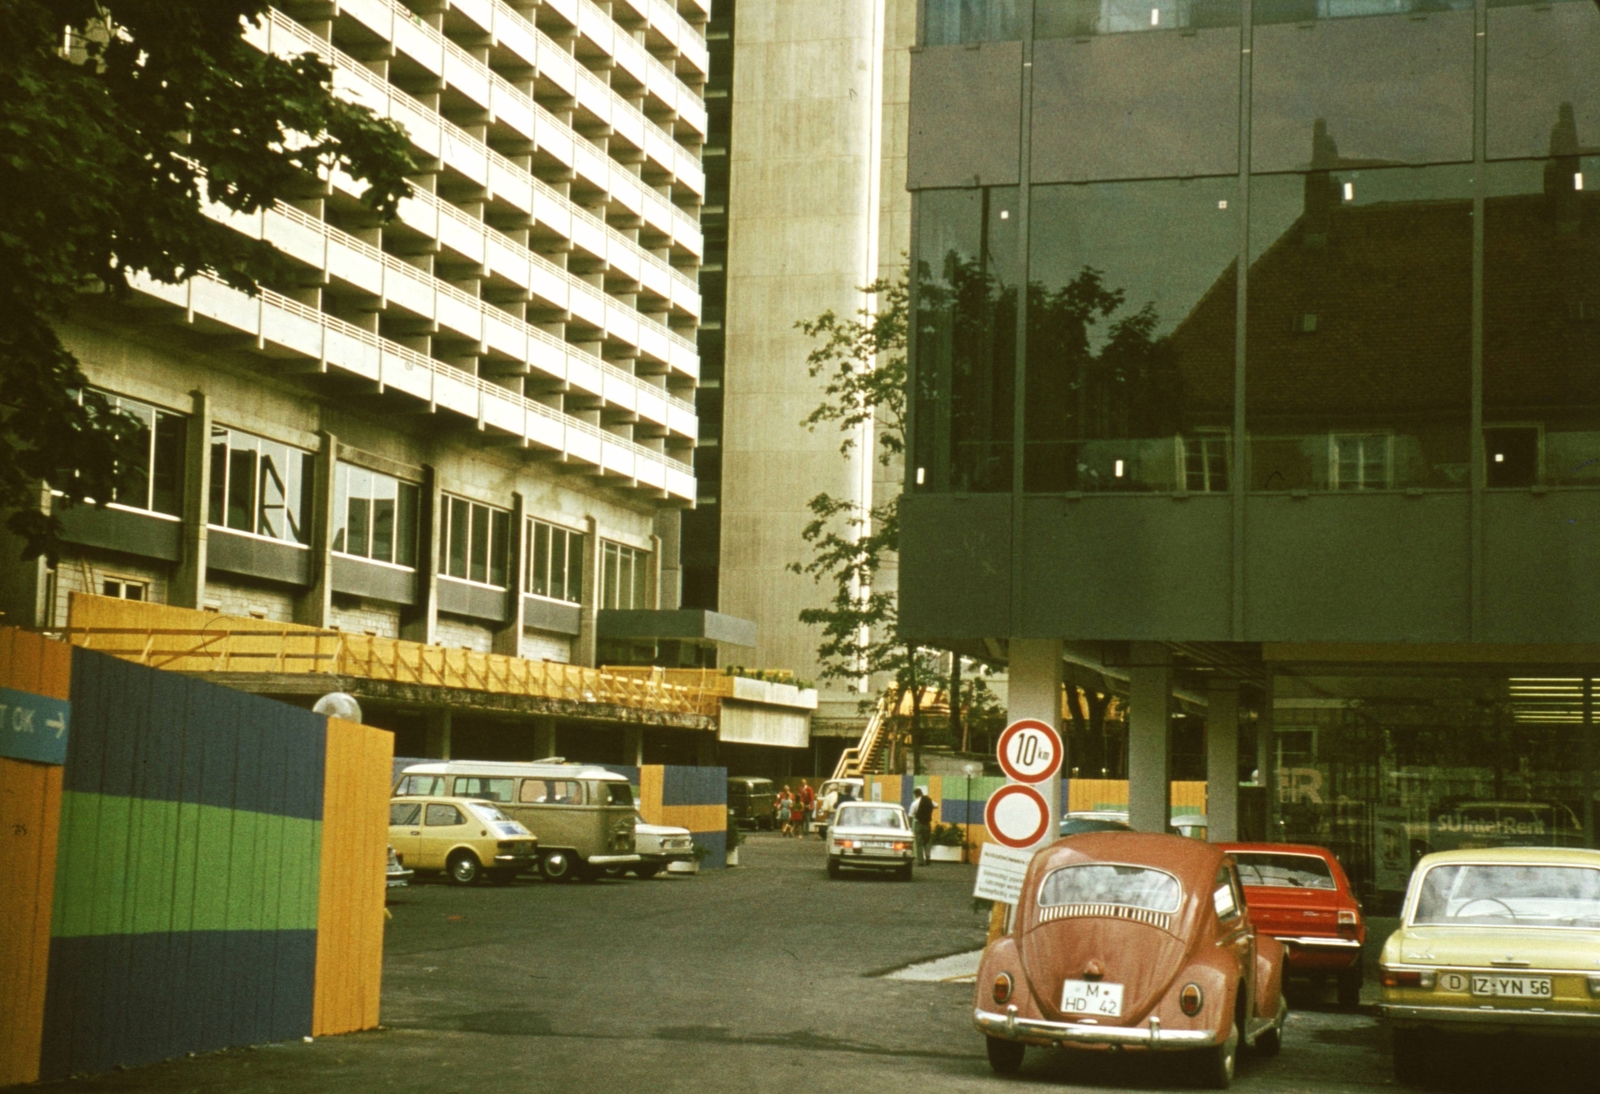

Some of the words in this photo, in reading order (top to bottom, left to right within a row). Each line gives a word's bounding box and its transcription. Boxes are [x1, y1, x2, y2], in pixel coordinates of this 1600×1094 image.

[12, 706, 36, 733] OK
[1015, 732, 1039, 766] 10
[1038, 747, 1050, 760] km
[1086, 983, 1100, 997] M
[1450, 976, 1461, 990] D
[1499, 979, 1523, 994] YN
[1530, 980, 1550, 995] 56
[1065, 997, 1087, 1011] HD
[1098, 1000, 1117, 1014] 42
